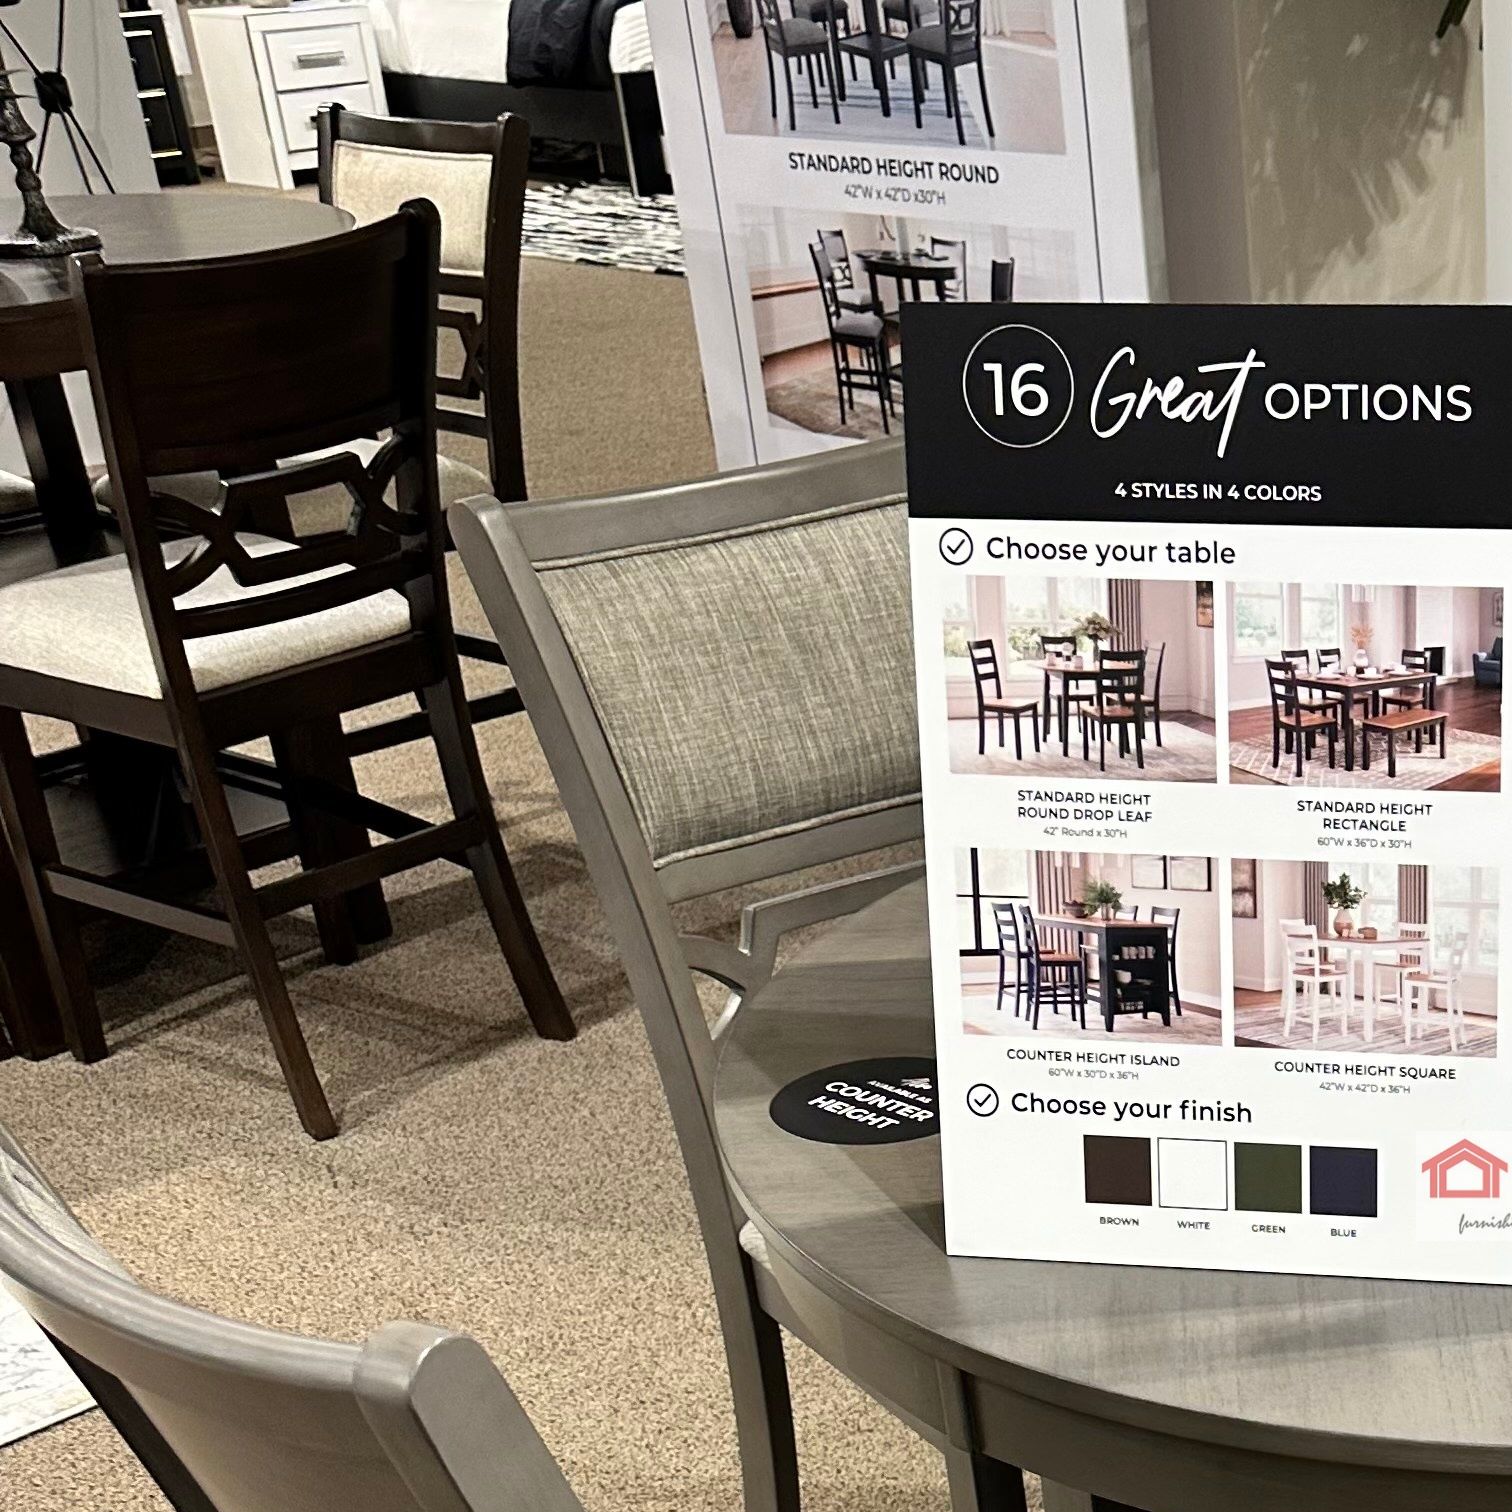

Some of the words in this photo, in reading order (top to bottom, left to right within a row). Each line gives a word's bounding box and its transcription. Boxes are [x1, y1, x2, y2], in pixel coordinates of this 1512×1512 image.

[789, 152, 872, 175] STANDARD
[876, 158, 934, 179] HEIGHT
[939, 162, 999, 184] ROUND
[875, 189, 883, 200] x
[983, 362, 1049, 417] 16
[1090, 346, 1265, 458] Great
[1265, 381, 1472, 423] OPTIONS
[1114, 482, 1127, 498] 4
[1131, 483, 1198, 499] STYLES
[1203, 484, 1222, 500] IN
[1227, 484, 1239, 500] 4
[1243, 484, 1322, 501] COLORS
[986, 536, 1087, 561] Choose
[1095, 541, 1158, 566] your
[1165, 541, 1235, 564] table
[1017, 790, 1095, 804] STANDARD
[1099, 792, 1151, 805] HEIGHT
[1018, 807, 1069, 820] ROUND
[1073, 809, 1114, 822] DROP
[1118, 810, 1153, 823] LEAF
[1297, 800, 1375, 814] STANDARD
[1379, 803, 1433, 816] HEIGHT
[1061, 826, 1094, 837] Round
[1323, 818, 1407, 832] RECTANGLE
[1006, 1048, 1072, 1062] COUNTER
[1076, 1052, 1126, 1065] HEIGHT
[1130, 1054, 1180, 1067] ISLAND
[1274, 1061, 1341, 1075] COUNTER
[1344, 1064, 1396, 1077] HEIGHT
[1399, 1066, 1457, 1080] SQUARE
[825, 1081, 934, 1122] COUNTER
[1011, 1093, 1107, 1116] Choose
[1113, 1100, 1172, 1121] your
[1179, 1100, 1252, 1123] finish
[808, 1095, 900, 1129] HEIGHT
[1099, 1216, 1140, 1227] BROWN
[1176, 1219, 1211, 1230] WHITE
[1251, 1224, 1286, 1234] GREEN
[1330, 1228, 1357, 1238] BLUE
